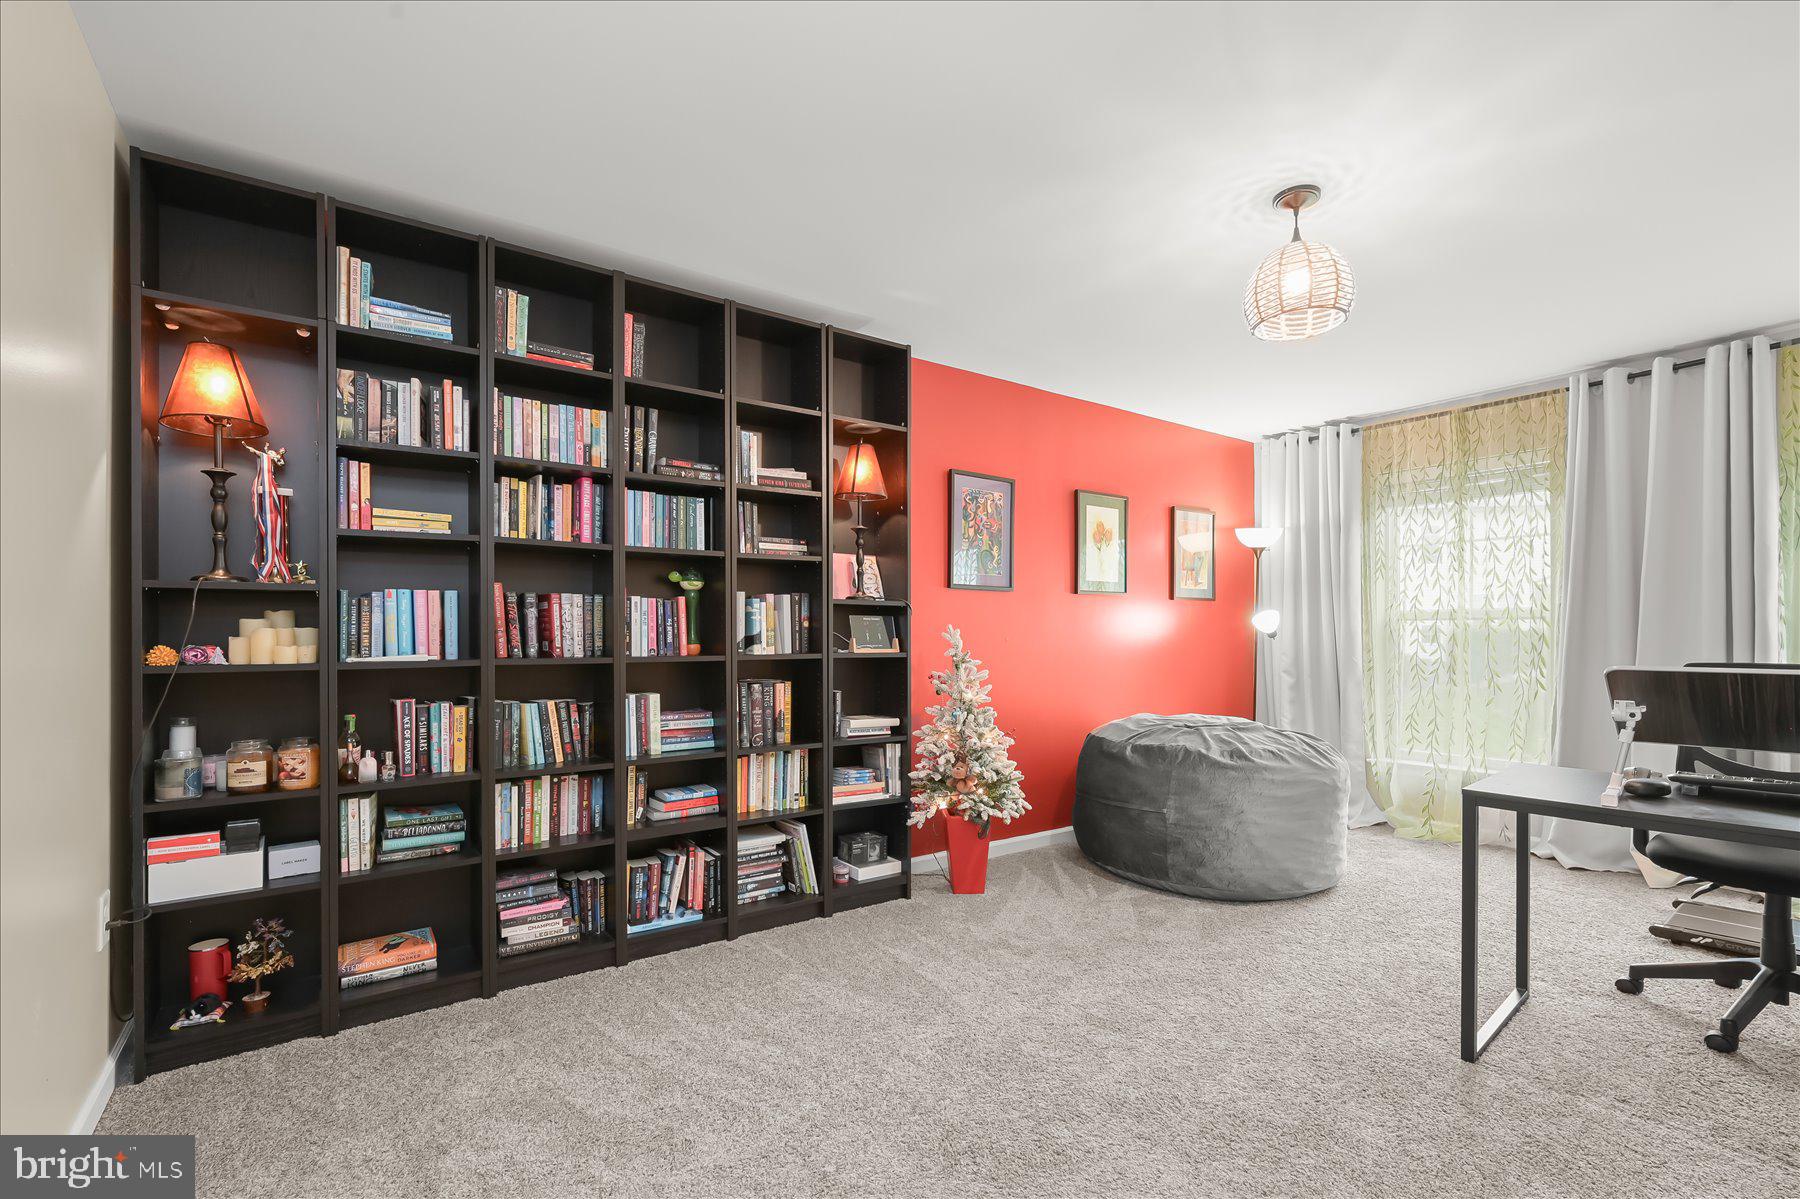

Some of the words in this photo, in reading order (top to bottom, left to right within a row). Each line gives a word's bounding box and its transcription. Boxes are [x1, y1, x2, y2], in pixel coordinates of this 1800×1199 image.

[374, 322, 394, 330] COLLEEN
[394, 325, 411, 333] HOOVER
[356, 393, 366, 415] LOCKE
[507, 603, 518, 620] FIVE
[360, 612, 370, 633] STEPHEN
[360, 634, 370, 647] KING
[509, 623, 520, 648] SURVIVE
[403, 715, 412, 729] ACE
[403, 729, 412, 739] OF
[419, 721, 428, 752] SIMILARS
[403, 739, 412, 765] SPADES
[527, 912, 560, 922] PRODIGY
[527, 921, 560, 931] CHAMPION
[534, 928, 564, 938] LEGEND
[397, 954, 421, 963] DARKER
[341, 961, 375, 974] STEPHEN
[375, 957, 396, 967] KING
[402, 962, 427, 973] NEVER
